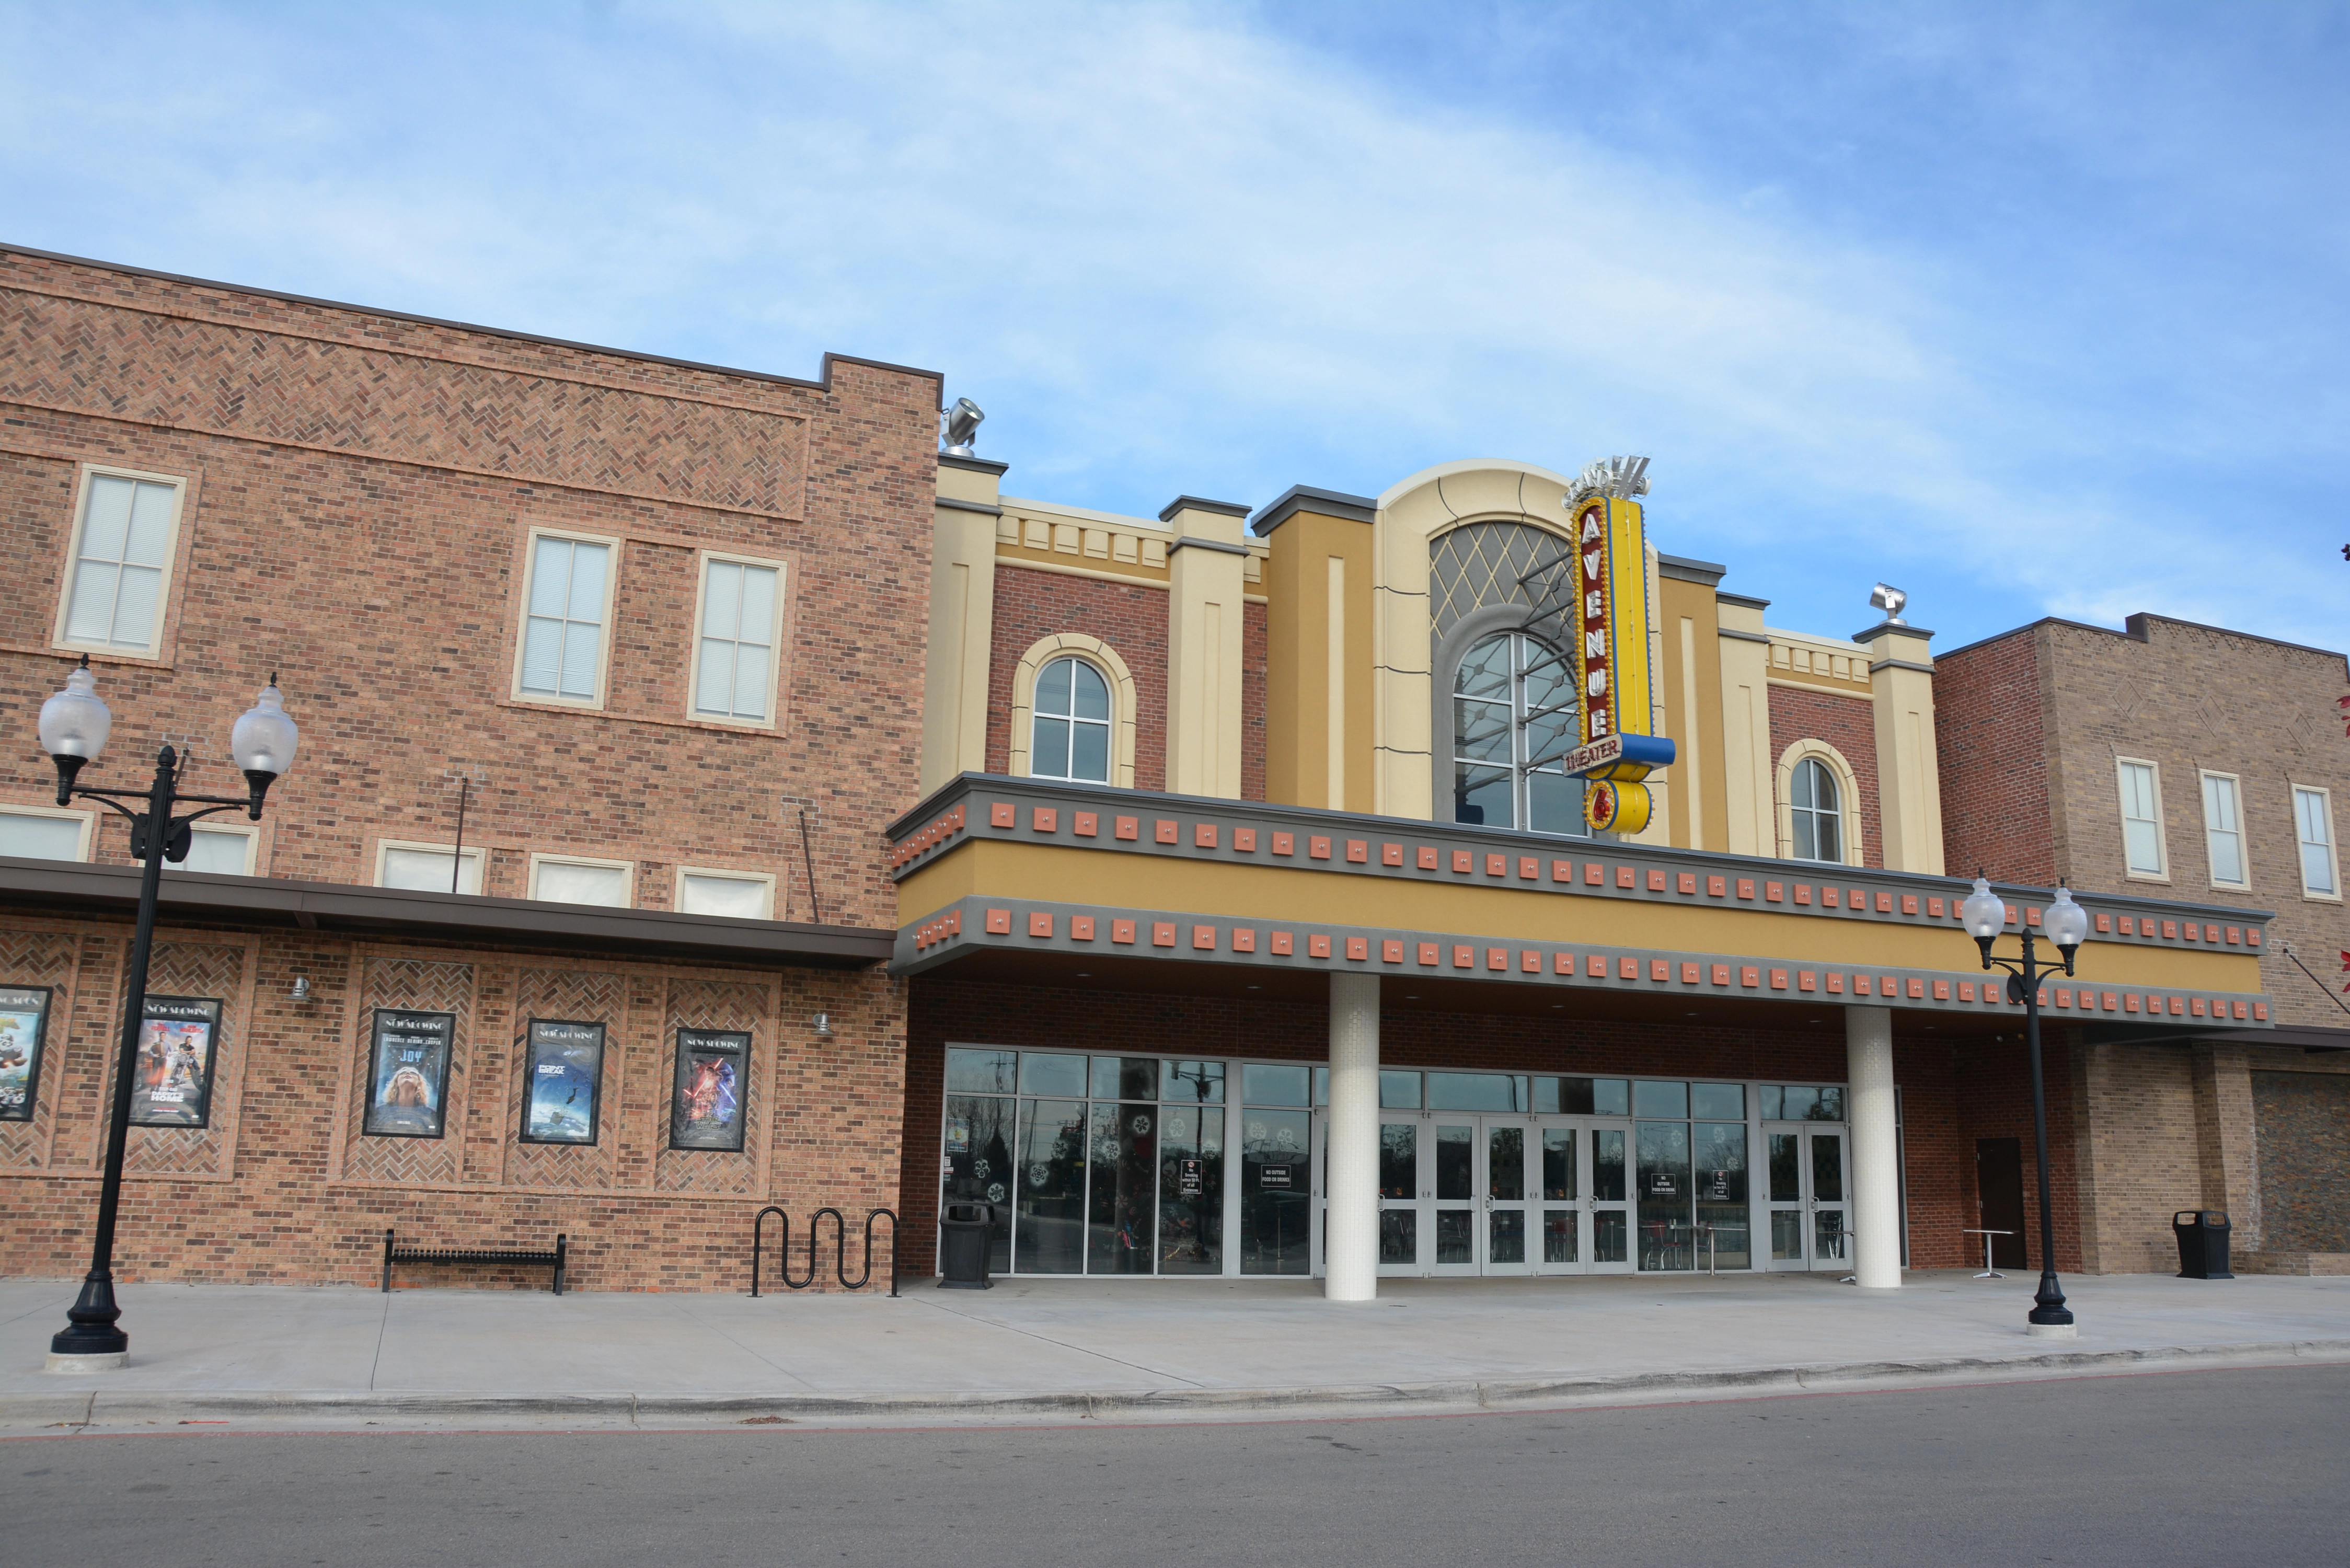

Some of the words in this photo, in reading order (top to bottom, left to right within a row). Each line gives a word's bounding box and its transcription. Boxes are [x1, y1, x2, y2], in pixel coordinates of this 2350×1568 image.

[1561, 469, 1614, 510] GRAND
[1582, 513, 1607, 737] AVENUE
[1566, 739, 1620, 771] THEATER
[1593, 788, 1611, 822] 6
[170, 1007, 209, 1016] SHOWING
[407, 1021, 444, 1030] SHOWING
[706, 1040, 740, 1048] SHOWING
[400, 1050, 422, 1062] JOY
